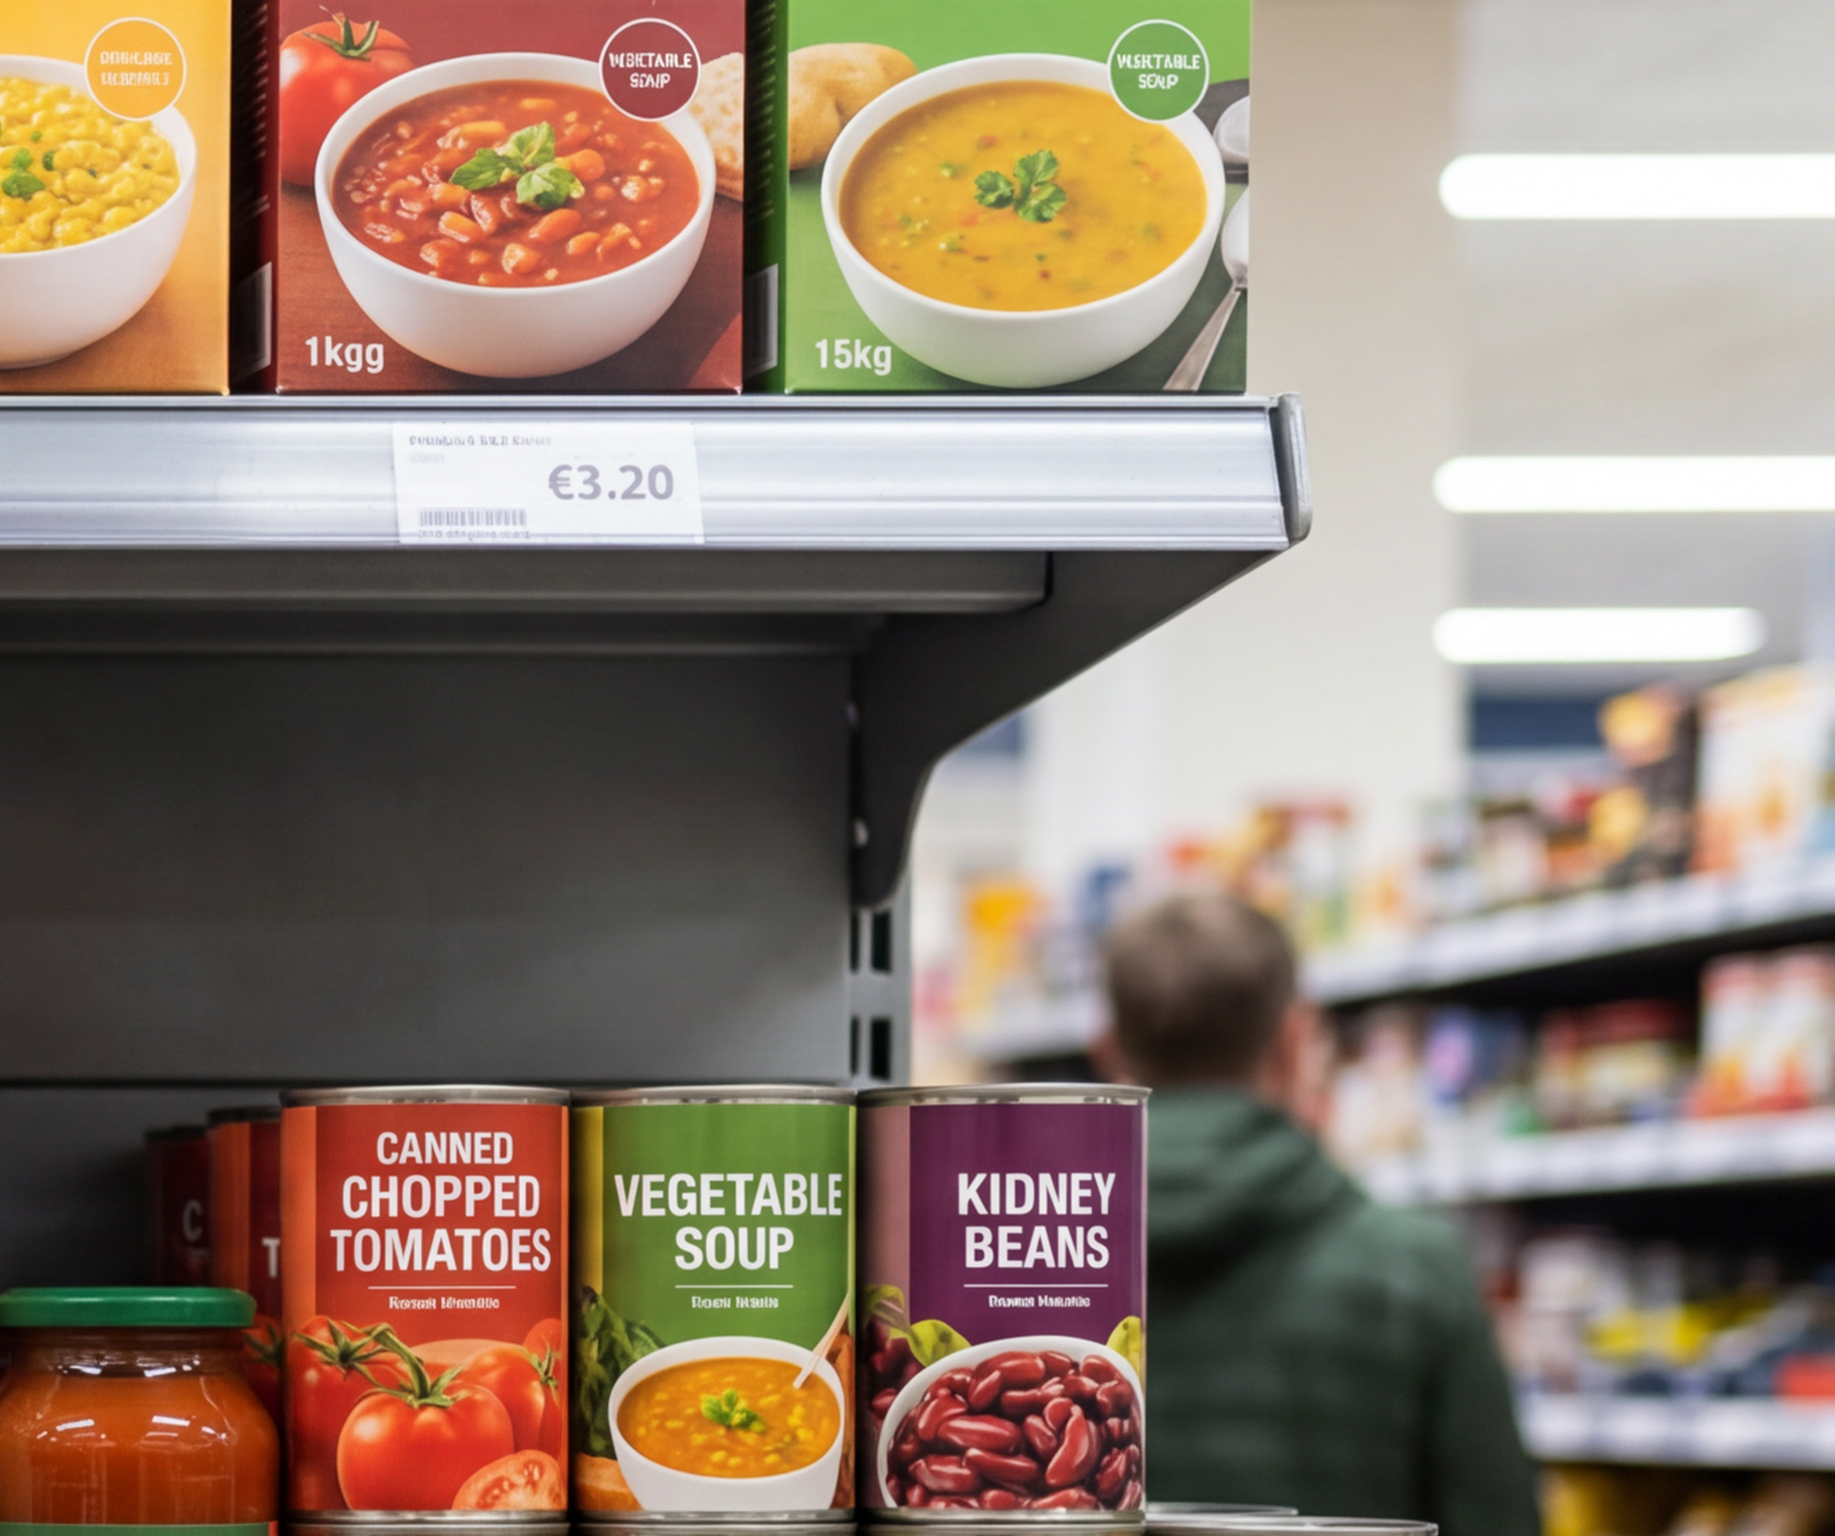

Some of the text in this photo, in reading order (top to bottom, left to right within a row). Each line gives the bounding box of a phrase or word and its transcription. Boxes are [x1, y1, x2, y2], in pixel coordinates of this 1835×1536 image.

[305, 336, 385, 374] 1kgg
[815, 339, 892, 377] 15kg
[549, 464, 674, 500] €3.20
[376, 1131, 513, 1165] CANNED
[342, 1174, 541, 1219] CHOPPED
[615, 1173, 842, 1217] VEGETABLE
[957, 1172, 1116, 1215] KIDNEY
[330, 1228, 551, 1273] TOMATOES
[675, 1226, 794, 1270] SOUP
[964, 1226, 1110, 1269] BEANS
